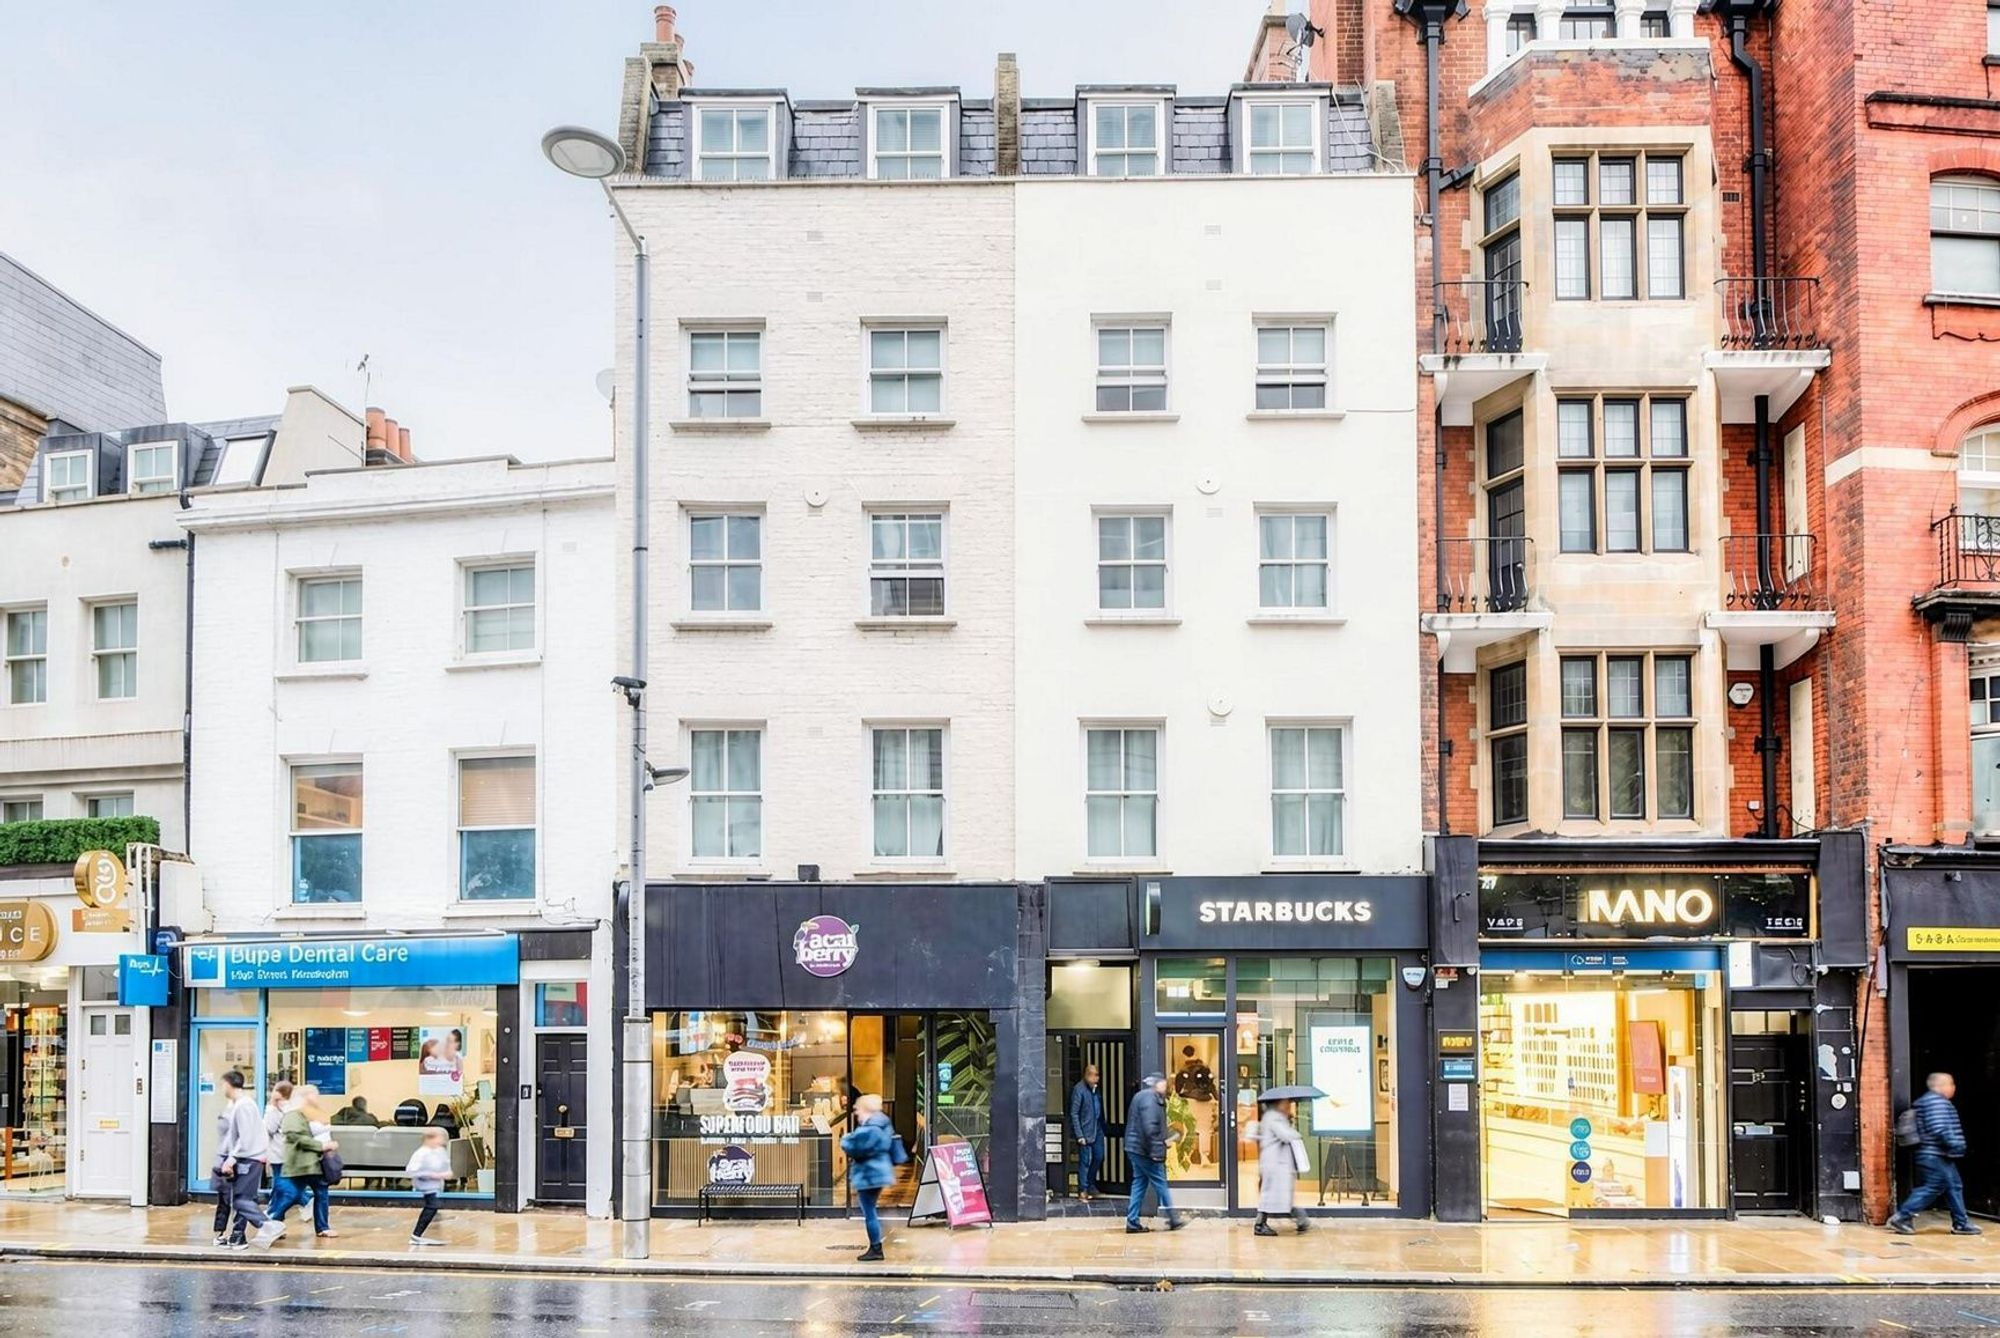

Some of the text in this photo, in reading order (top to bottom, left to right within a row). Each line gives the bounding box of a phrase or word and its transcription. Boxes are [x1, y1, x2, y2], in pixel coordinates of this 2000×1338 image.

[1199, 901, 1372, 922] STARBUCKS
[288, 944, 355, 963] Dental
[361, 944, 409, 962] Care
